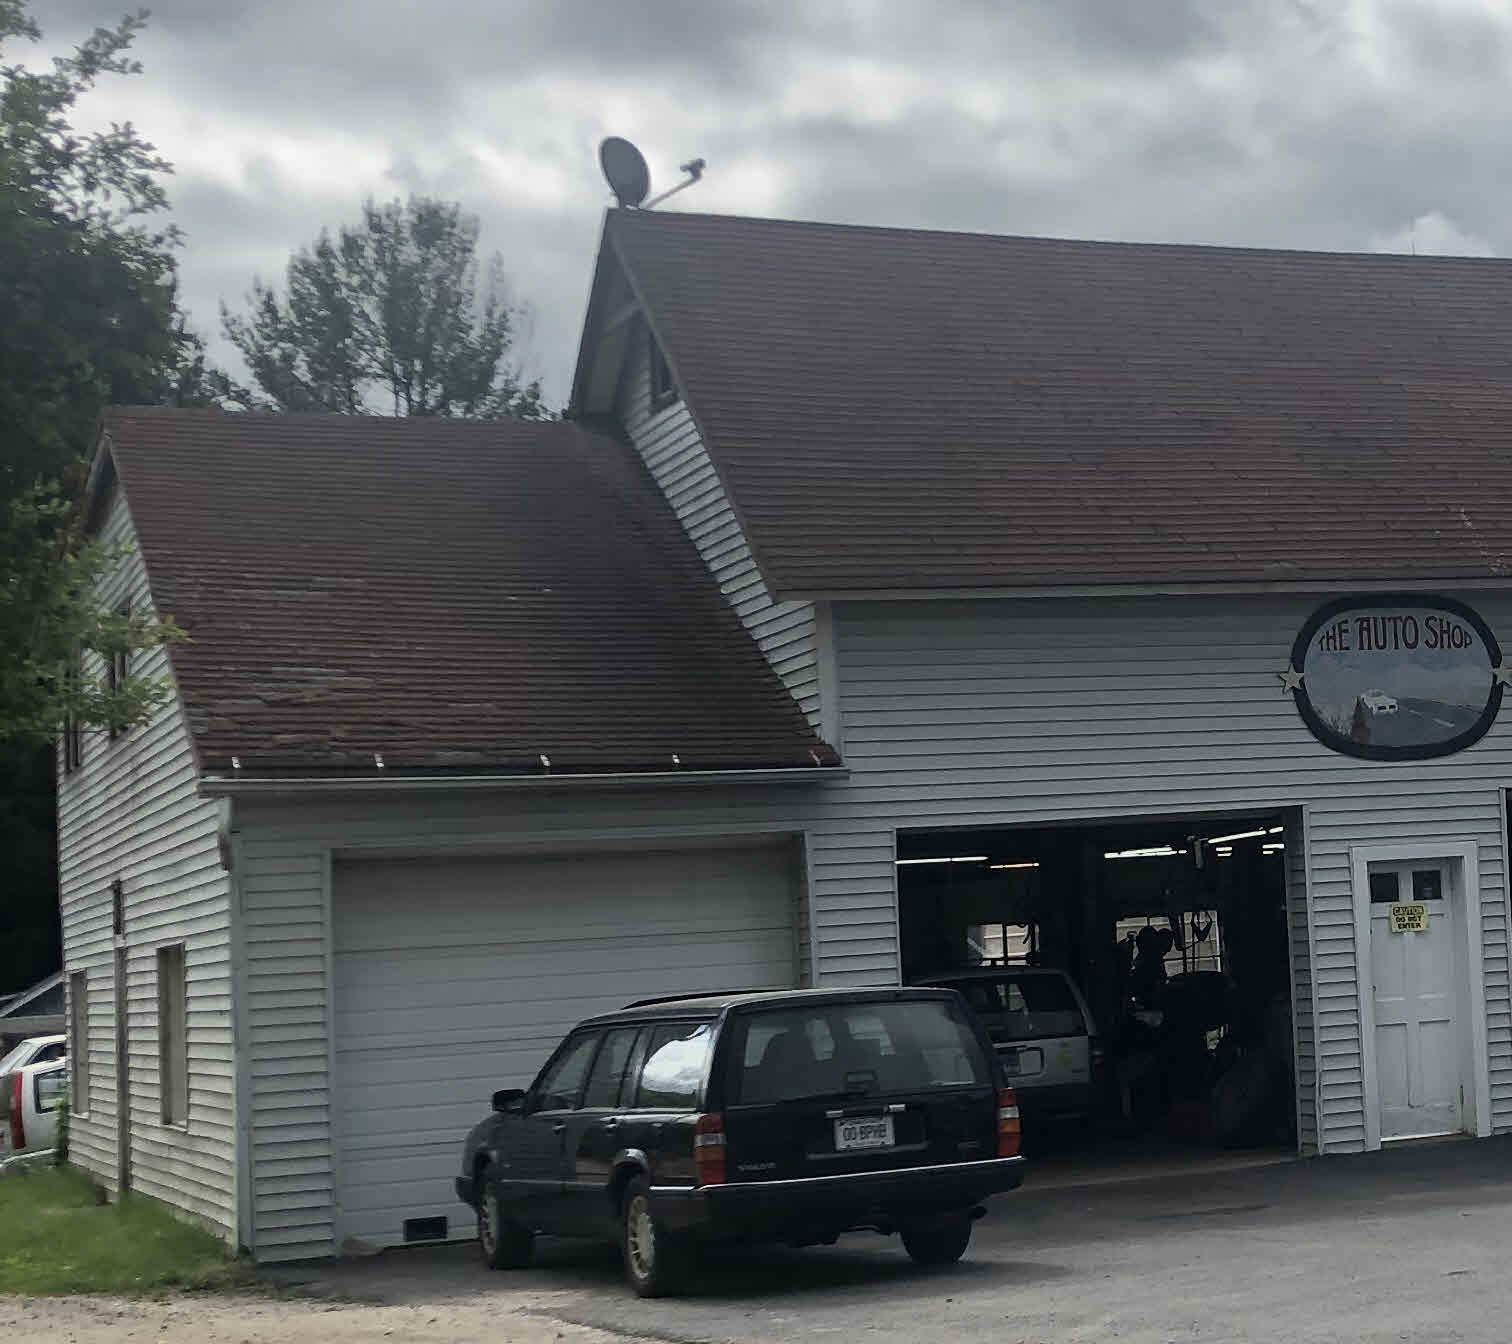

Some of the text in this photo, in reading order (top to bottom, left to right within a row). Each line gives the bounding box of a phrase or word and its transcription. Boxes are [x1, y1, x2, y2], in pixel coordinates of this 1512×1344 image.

[1318, 615, 1473, 651] THE AUTO SHOP
